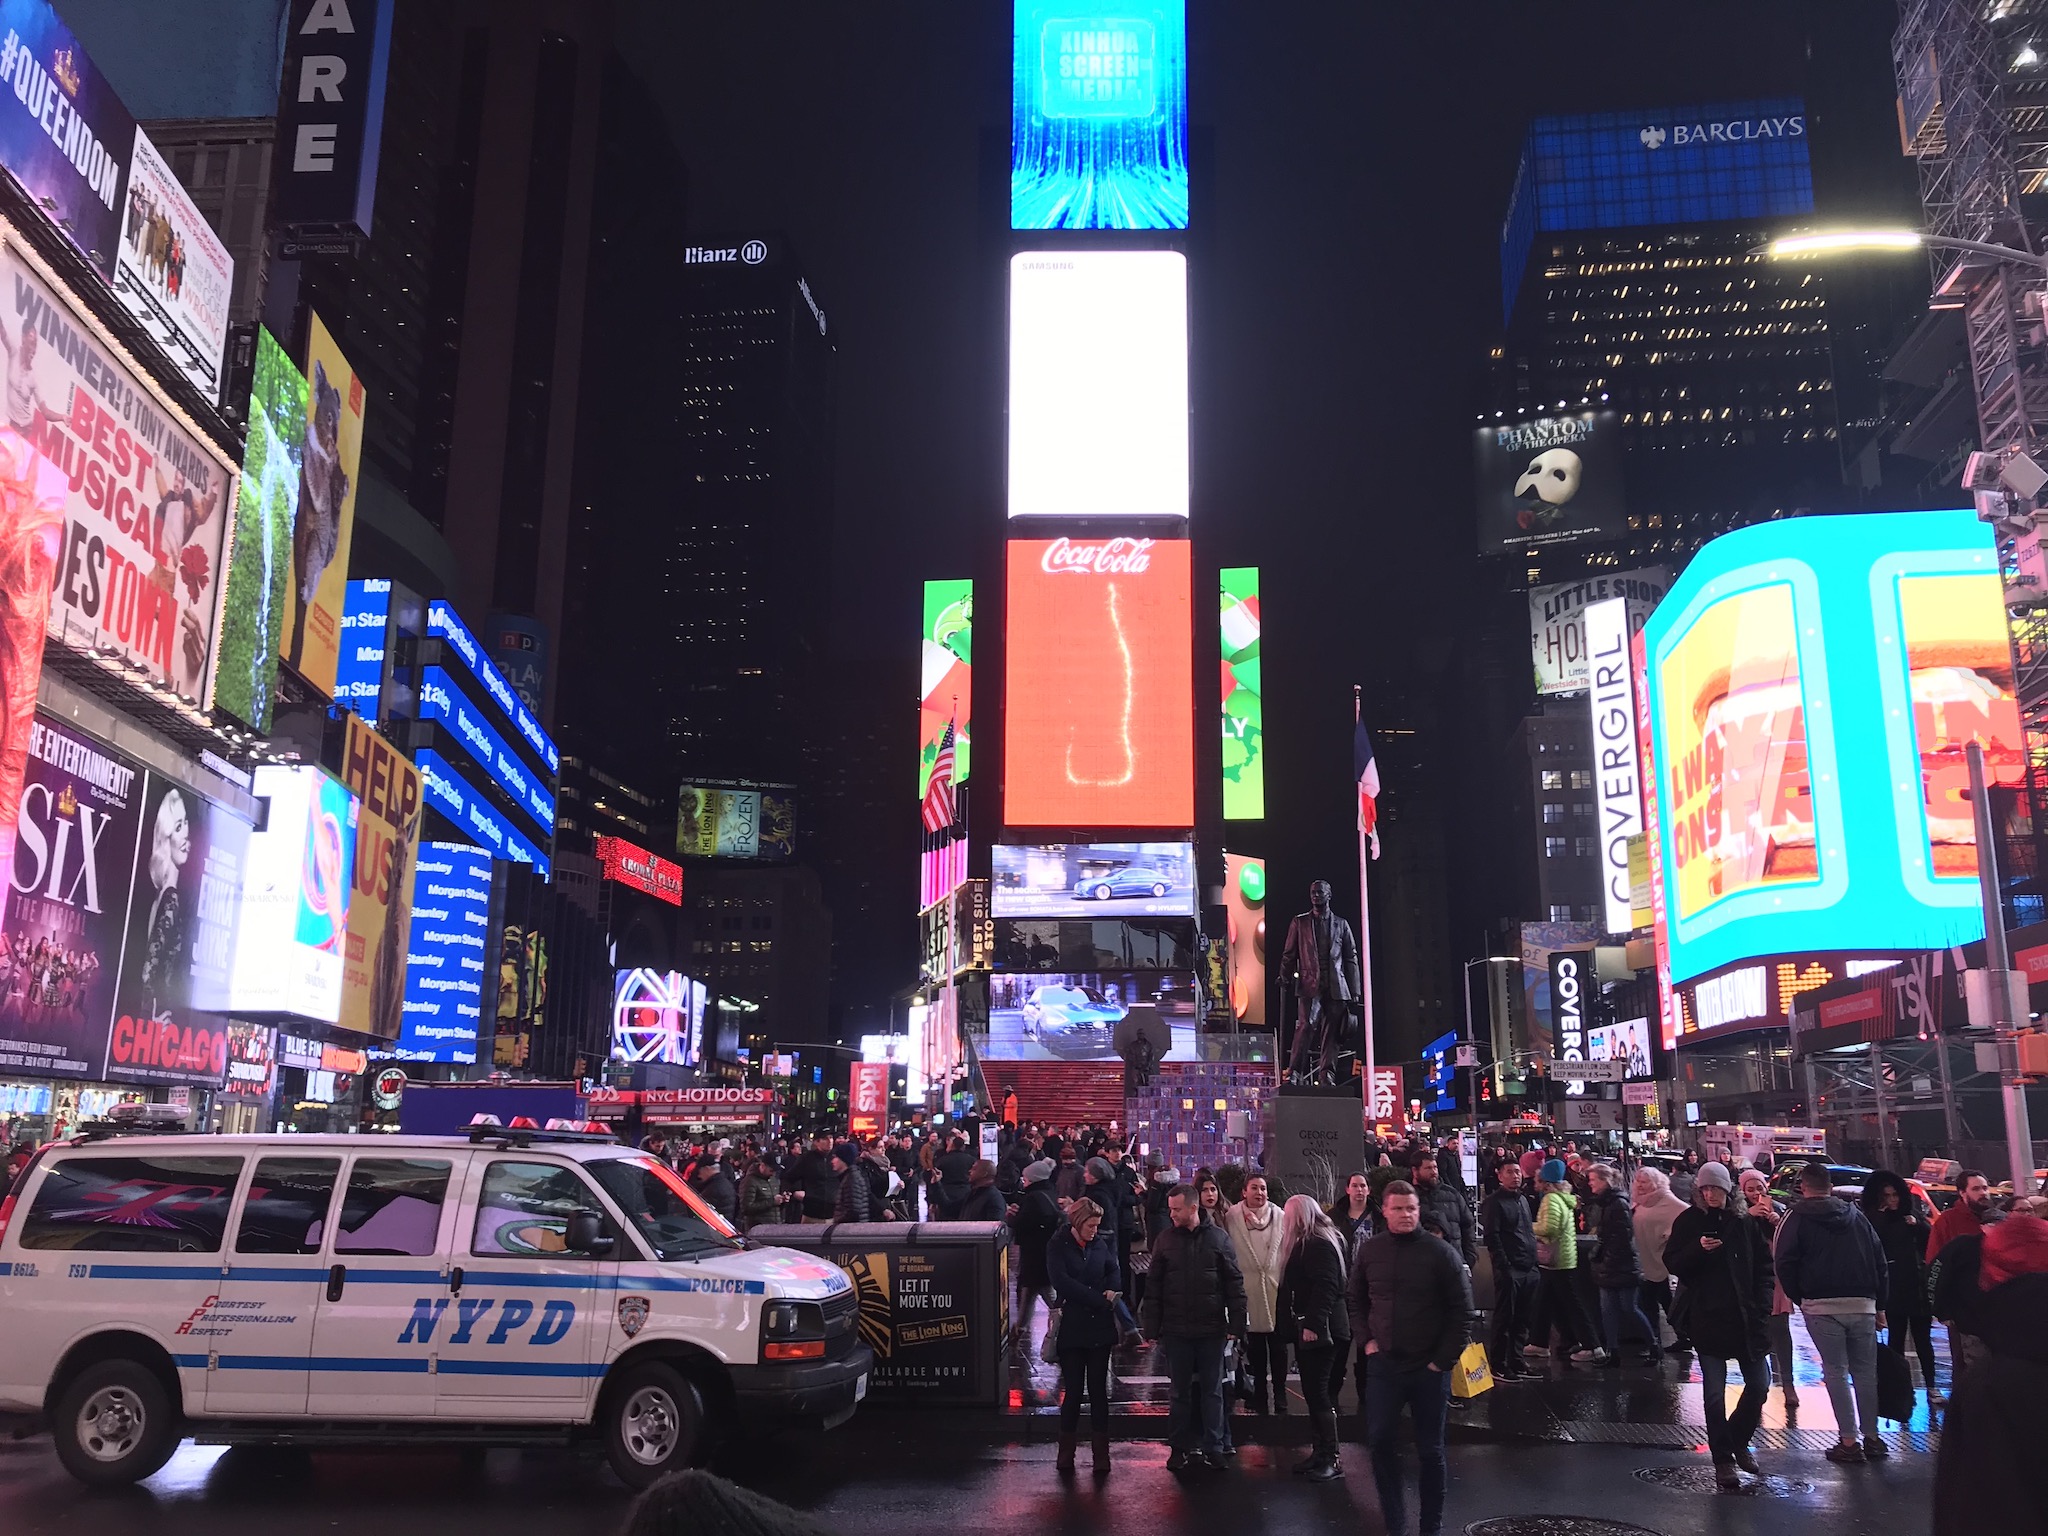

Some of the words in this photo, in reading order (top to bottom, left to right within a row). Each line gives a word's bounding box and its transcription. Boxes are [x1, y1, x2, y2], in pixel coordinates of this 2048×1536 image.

[1059, 31, 1139, 53] XINHUA
[1059, 55, 1139, 77] SCREEN
[1060, 79, 1141, 100] MEDIA
[0, 28, 119, 211] #QUEENDOM
[1673, 116, 1803, 145] BARCLAYS
[1022, 262, 1074, 271] SAMSUNG
[15, 272, 124, 412] WINNER!
[124, 387, 132, 421] 8
[134, 398, 166, 458] TONY
[164, 430, 209, 495] AWARDS
[71, 385, 154, 493] BEST
[1497, 418, 1594, 446] PHANTOM
[1506, 443, 1523, 453] OF
[1523, 439, 1548, 450] THE
[1547, 433, 1586, 446] OPERA
[30, 408, 168, 566] MUSICAL
[1543, 579, 1608, 622] LITTLE
[1613, 578, 1663, 601] SHOP
[1543, 679, 1577, 691] Westside
[347, 722, 418, 828] HELP
[1595, 633, 1635, 903] COVERGIRL
[702, 792, 714, 813] KING
[700, 815, 713, 835] LION
[733, 794, 754, 853] FROZEN
[9, 783, 112, 914] SIX
[702, 837, 711, 852] THE
[359, 822, 393, 905] US
[415, 861, 453, 875] Stanley
[1647, 795, 1665, 923] CHOCOLATE
[621, 857, 655, 881] CROWNE
[658, 872, 680, 892] PLAZA
[428, 884, 466, 899] Morgan
[996, 885, 1013, 895] The
[15, 895, 37, 922] THE
[973, 883, 983, 919] SIDE
[40, 903, 87, 936] MUSICAL
[411, 906, 449, 921] Stanley
[423, 930, 462, 945] Morgan
[973, 923, 983, 963] WEST
[406, 953, 445, 968] Stanley
[1522, 949, 1541, 960] of
[419, 977, 457, 992] Morgan
[1892, 954, 1936, 1032] TSX
[402, 1000, 440, 1015] Stanley
[415, 1025, 454, 1039] Morgan
[113, 1014, 224, 1073] CHICAGO
[286, 1036, 307, 1056] BLUE
[309, 1041, 323, 1057] FIN
[1553, 1062, 1583, 1071] PEDESTRIAN
[646, 1093, 675, 1103] NYC
[677, 1087, 764, 1102] HOTDOGS
[860, 1068, 880, 1112] tkts
[1374, 1070, 1397, 1119] tkts
[1578, 1103, 1599, 1114] LOL
[1299, 1130, 1339, 1140] GEORGE
[1302, 1148, 1338, 1157] COHAN
[691, 1278, 745, 1293] POLICE
[900, 1279, 917, 1292] LET
[921, 1279, 930, 1292] IT
[1927, 1259, 1942, 1291] ASPEN
[201, 1295, 266, 1309] COURTESY
[900, 1294, 928, 1309] MOVE
[931, 1295, 952, 1308] YOU
[187, 1308, 297, 1323] PROFESSIONALISM
[397, 1298, 576, 1345] NYPD
[174, 1322, 233, 1336] RESPECT
[902, 1331, 919, 1341] THE
[919, 1326, 941, 1340] LION
[941, 1322, 964, 1336] KING
[873, 1367, 926, 1376] AILABLE
[935, 1367, 967, 1376] NOW!
